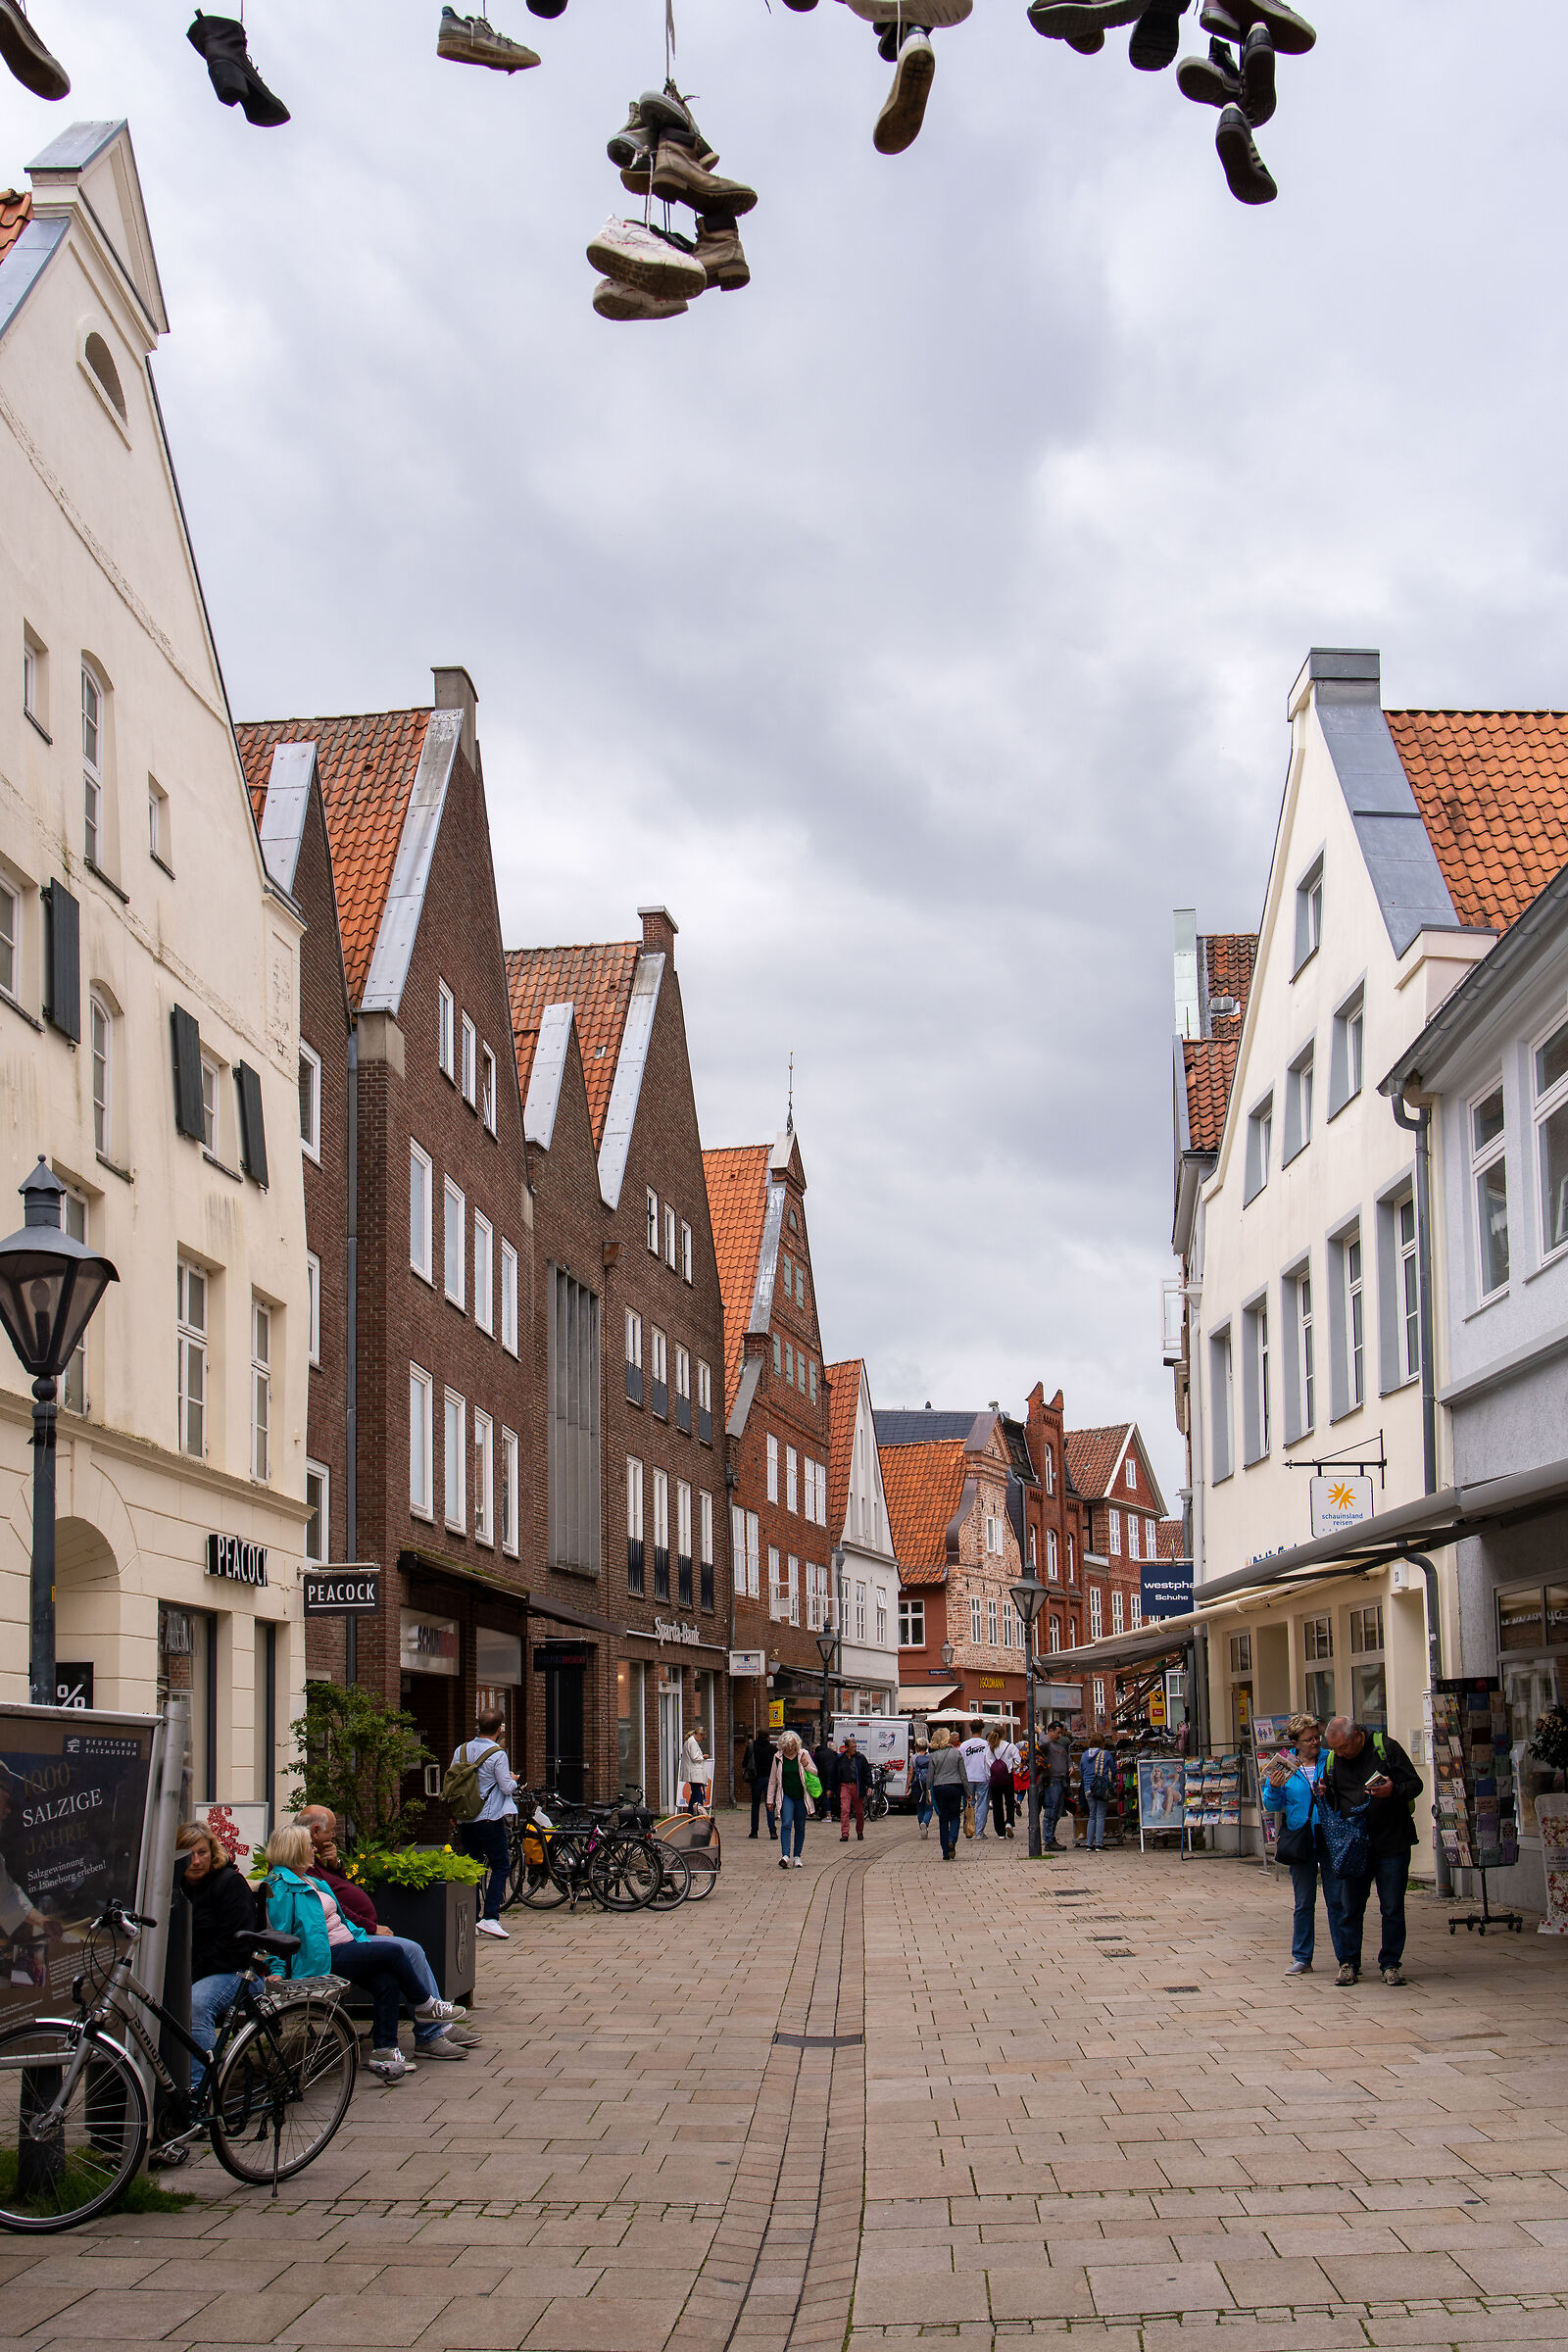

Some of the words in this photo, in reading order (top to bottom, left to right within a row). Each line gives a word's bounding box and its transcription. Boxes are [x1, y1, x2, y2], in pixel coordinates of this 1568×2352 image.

[218, 1535, 269, 1587] PEACOCK
[308, 1583, 375, 1601] PEACOCK
[1144, 1580, 1194, 1591] westpha
[655, 1616, 700, 1646] Sparda-Bank
[85, 1739, 138, 1748] DEUTSCHES
[85, 1747, 137, 1756] SALZMUSEUM
[23, 1761, 71, 1798] 1000
[23, 1788, 104, 1828] SALZIGE
[25, 1822, 88, 1856] JAHRE
[27, 1857, 85, 1882] Salzgewinnung
[28, 1884, 37, 1893] in
[38, 1872, 76, 1891] Lüneburg
[76, 1860, 107, 1879] erleben!
